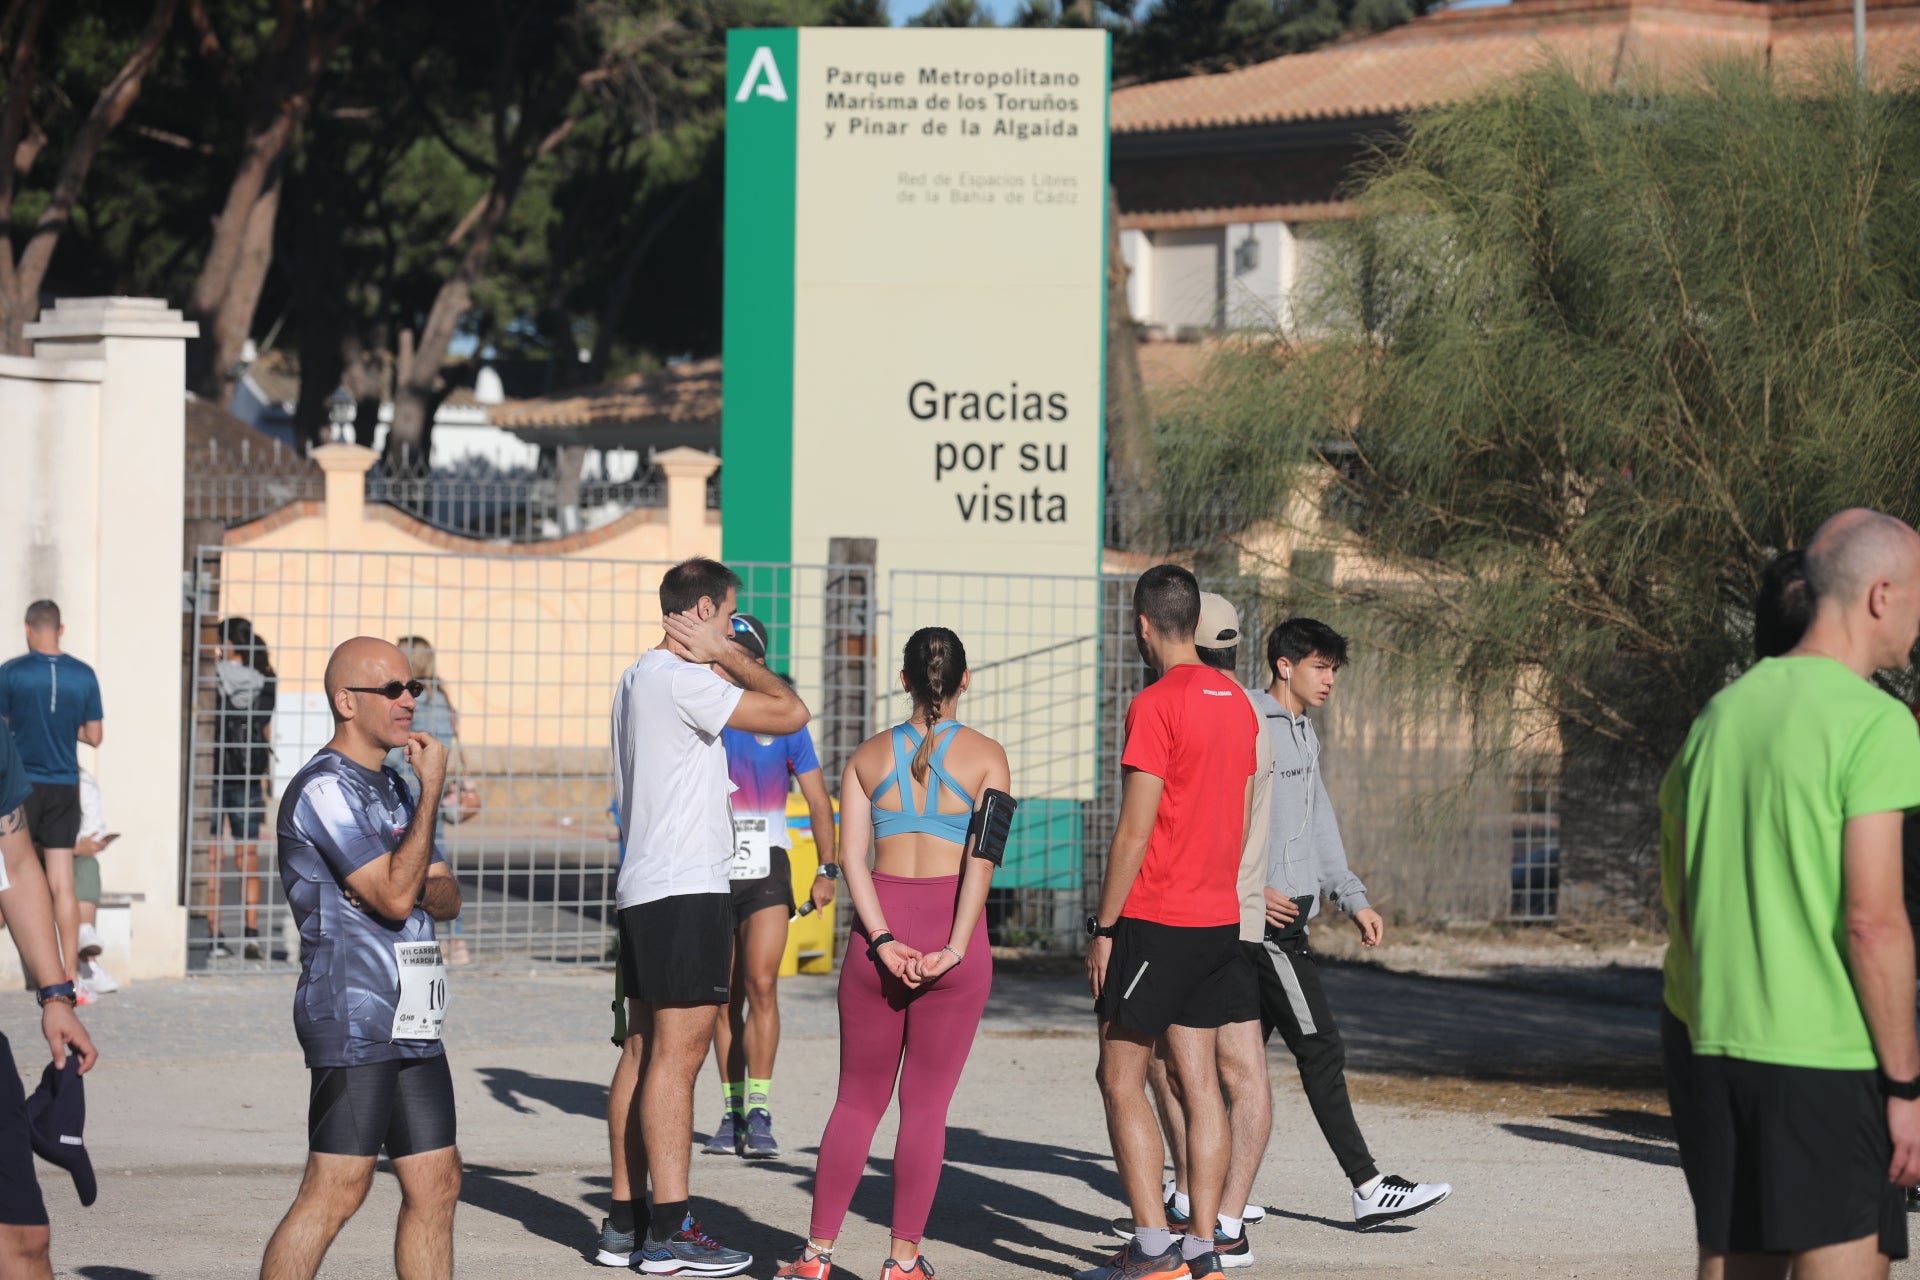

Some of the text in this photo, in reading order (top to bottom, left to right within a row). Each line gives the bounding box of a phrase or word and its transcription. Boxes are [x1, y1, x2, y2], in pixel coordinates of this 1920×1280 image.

[826, 67, 1080, 88] Parque Metropolitano
[826, 93, 1079, 112] Marisma de los Toruños
[825, 117, 1079, 140] y Pinar de la Algaida
[897, 172, 1078, 189] Red de Espacios Libres
[897, 190, 916, 204] de
[925, 190, 941, 204] la
[1005, 191, 1025, 205] de
[907, 379, 1070, 423] Gracias
[934, 440, 1068, 483] por su
